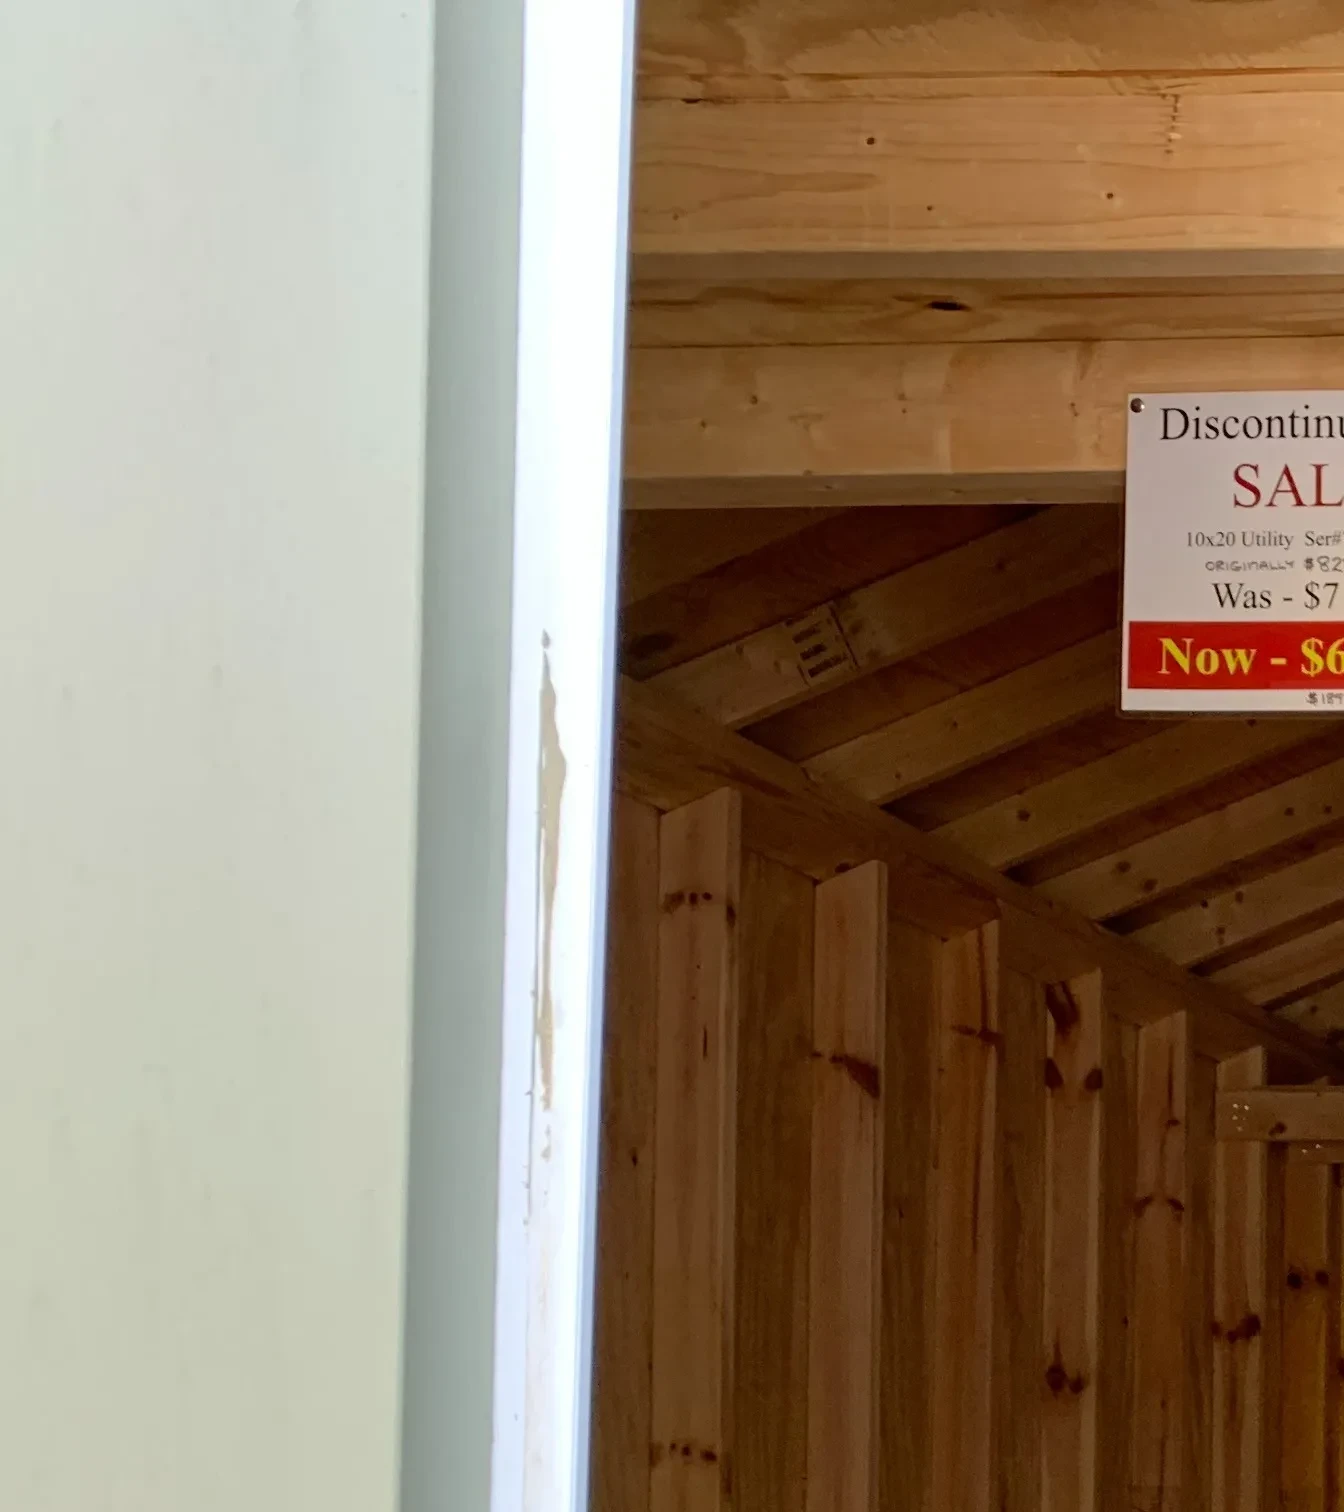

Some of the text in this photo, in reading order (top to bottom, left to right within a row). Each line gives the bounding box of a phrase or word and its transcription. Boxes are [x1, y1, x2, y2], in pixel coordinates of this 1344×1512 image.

[1186, 531, 1236, 548] 10x20
[1241, 530, 1294, 551] Utility
[1212, 582, 1272, 609] Was
[1157, 637, 1257, 676] Now
